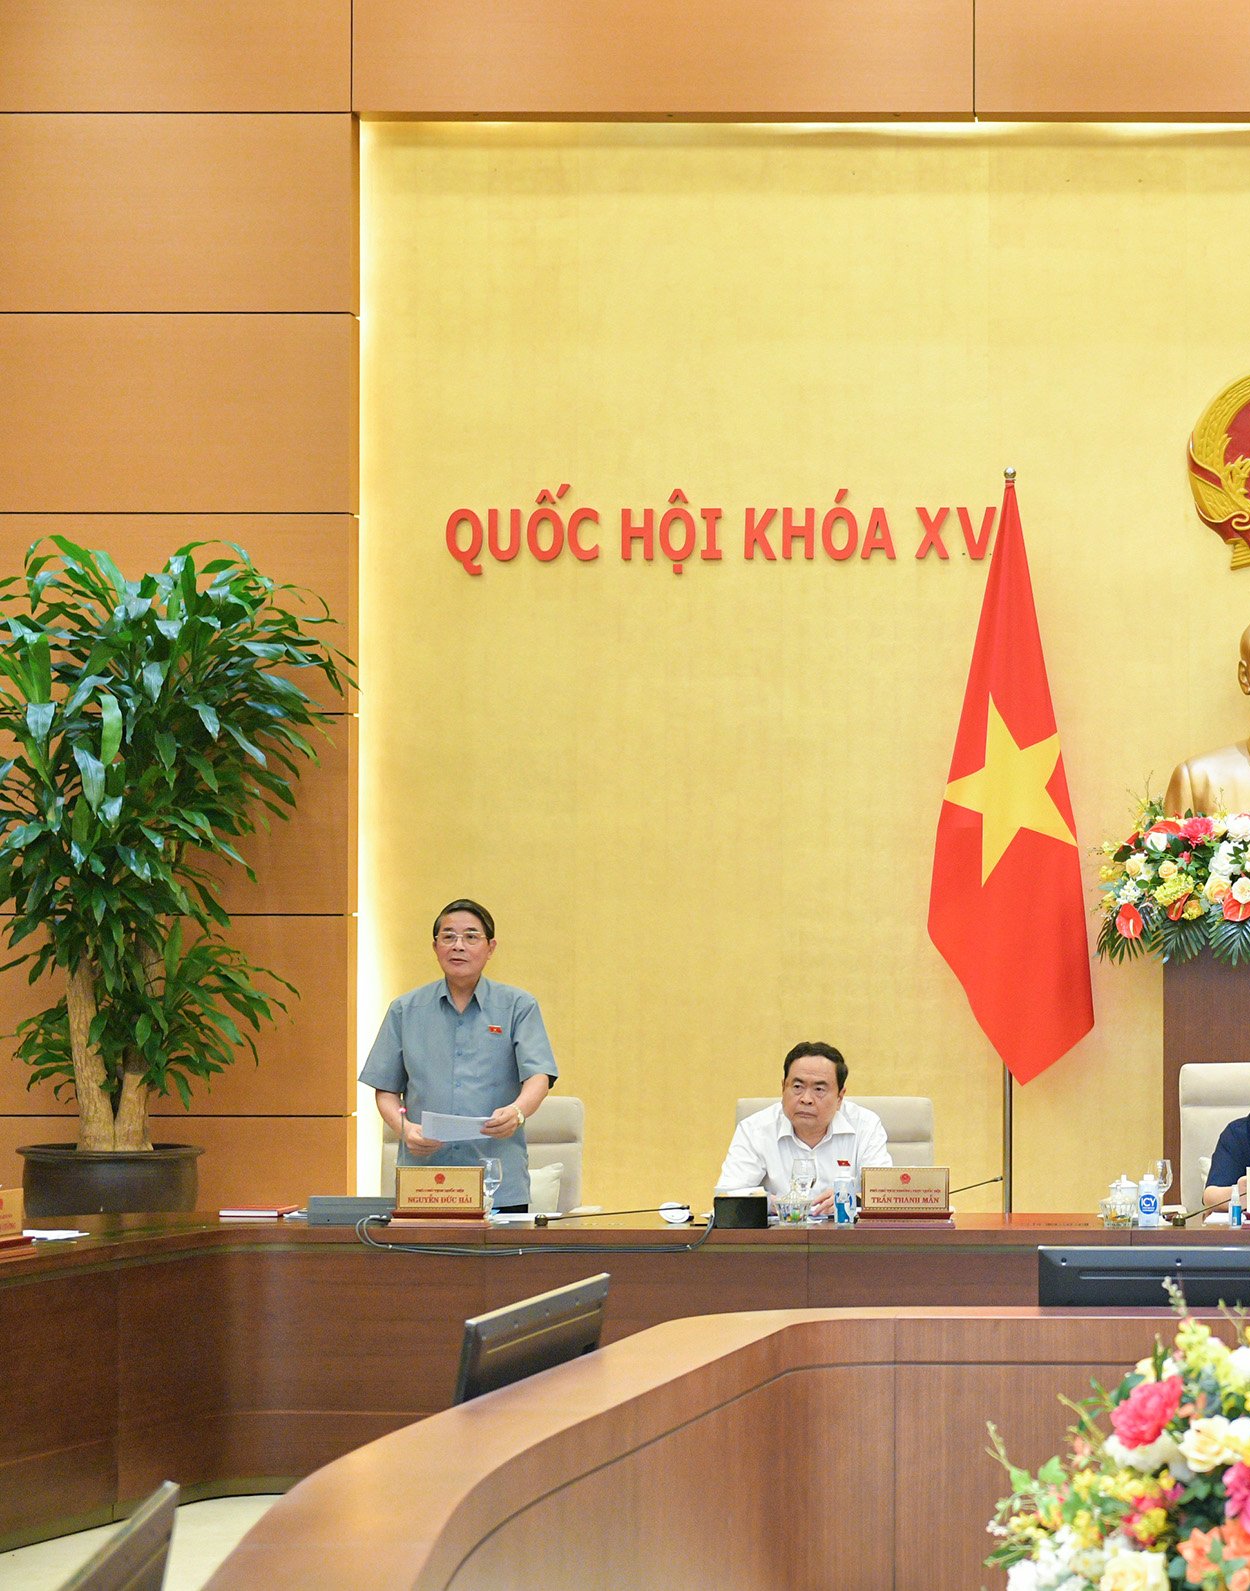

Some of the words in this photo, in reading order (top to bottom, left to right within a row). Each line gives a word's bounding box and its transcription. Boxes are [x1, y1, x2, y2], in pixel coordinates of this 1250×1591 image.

[446, 484, 599, 575] QUỐC
[621, 489, 722, 573] HỘI
[744, 489, 896, 560] KHÓA
[916, 507, 997, 560] XV
[1141, 1197, 1156, 1207] ICY
